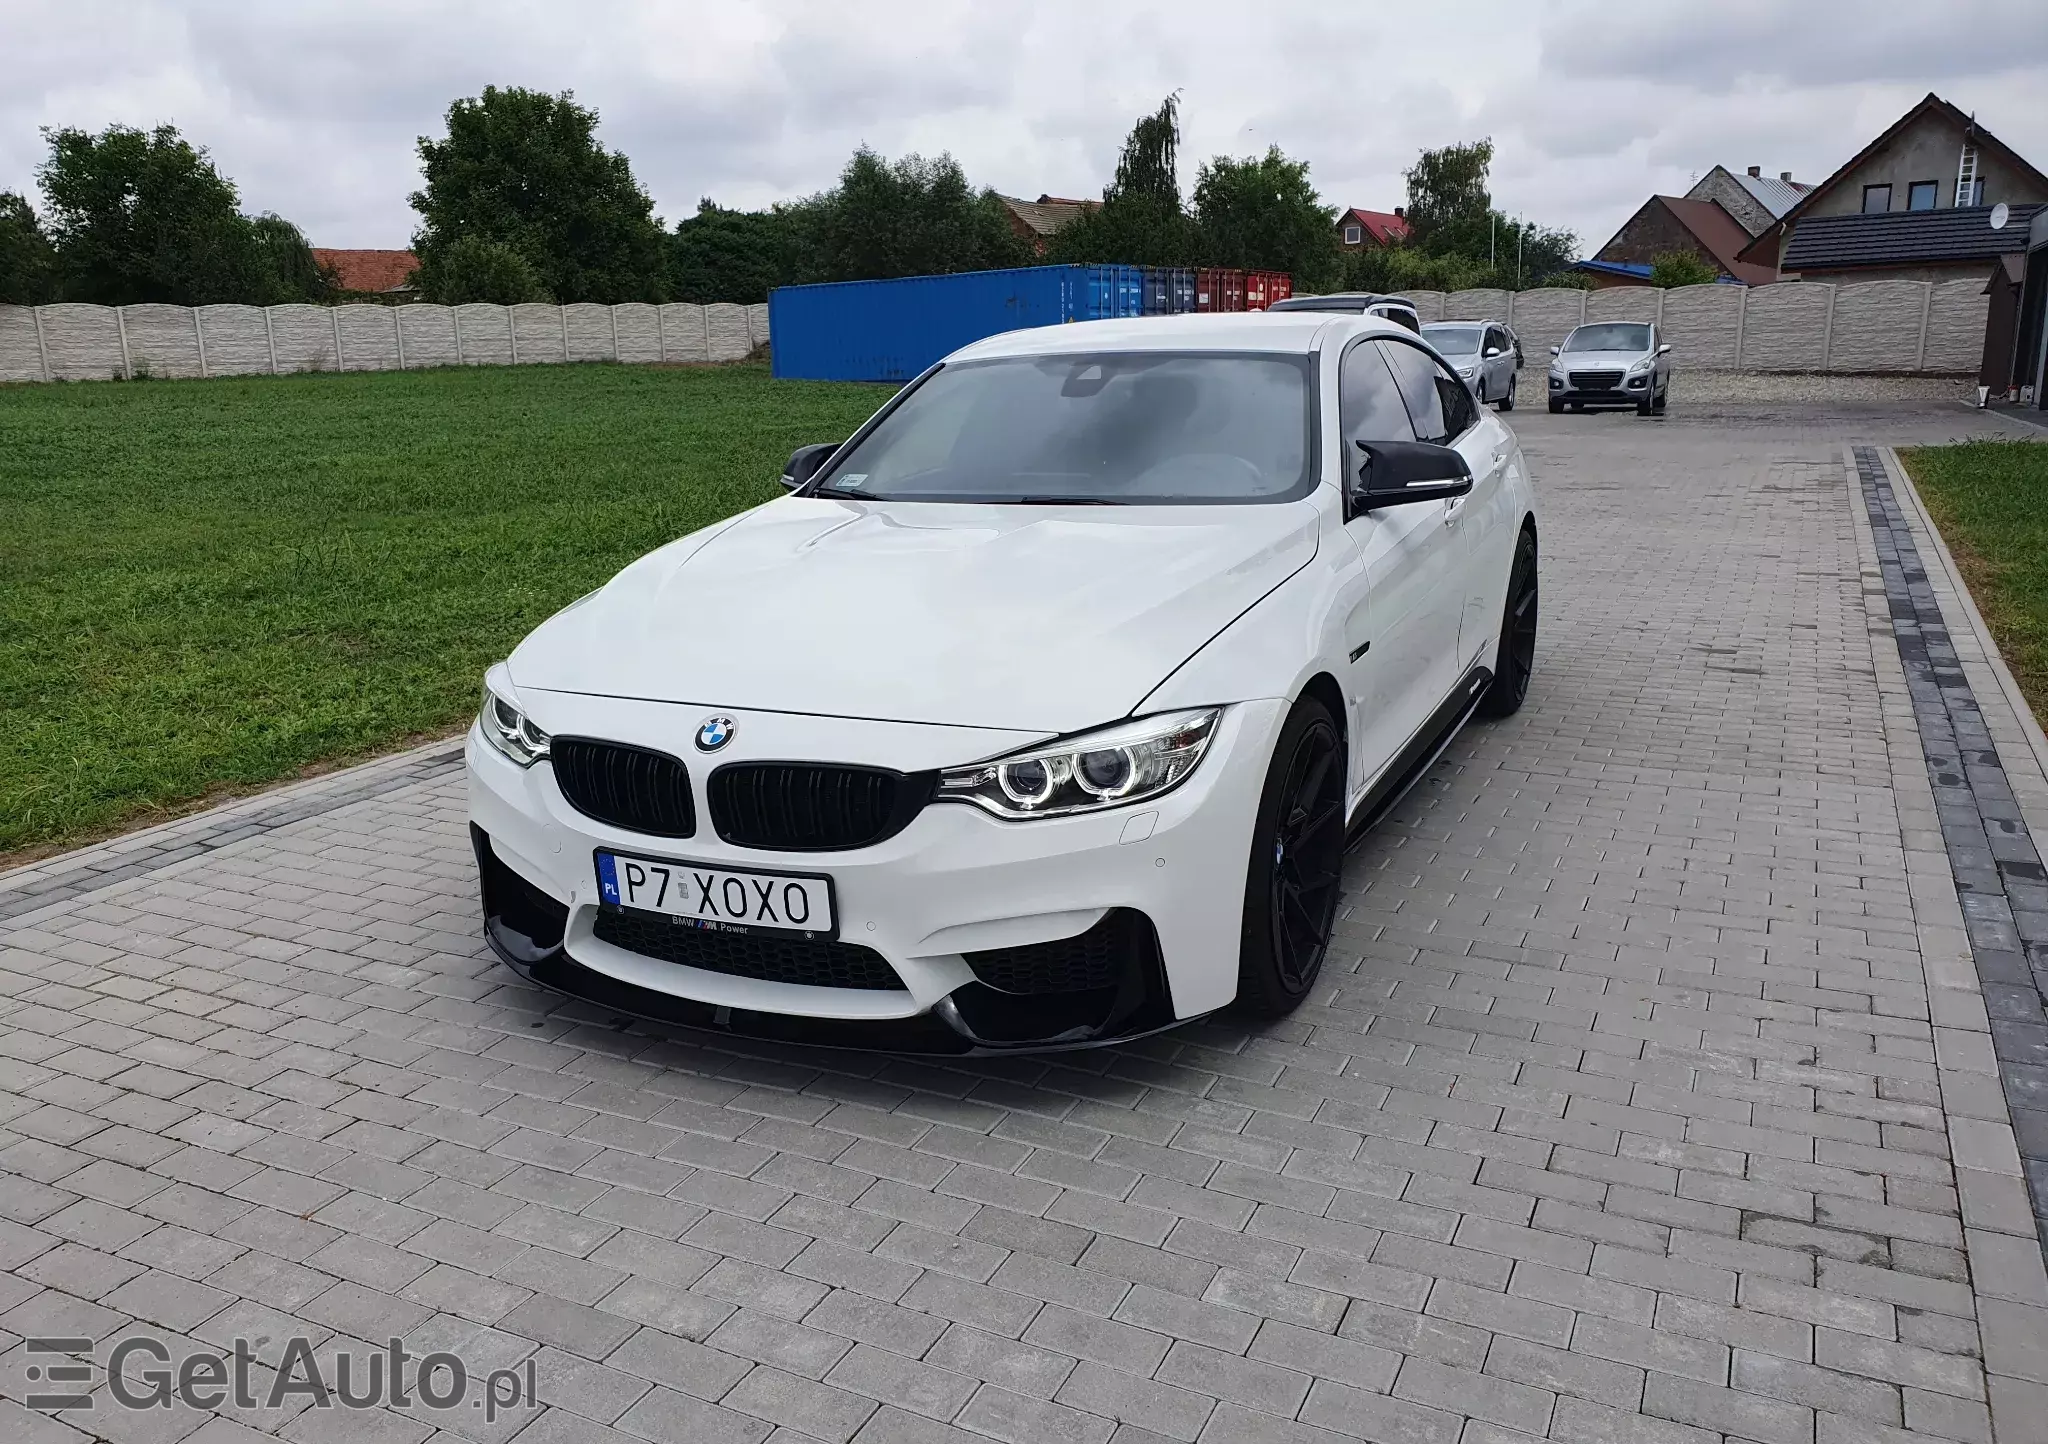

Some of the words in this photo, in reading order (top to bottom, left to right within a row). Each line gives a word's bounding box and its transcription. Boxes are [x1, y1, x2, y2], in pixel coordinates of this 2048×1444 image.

[604, 882, 618, 896] PL
[625, 862, 670, 908] P7
[693, 873, 810, 924] XOXO
[671, 915, 695, 928] BMW
[720, 922, 749, 935] Power
